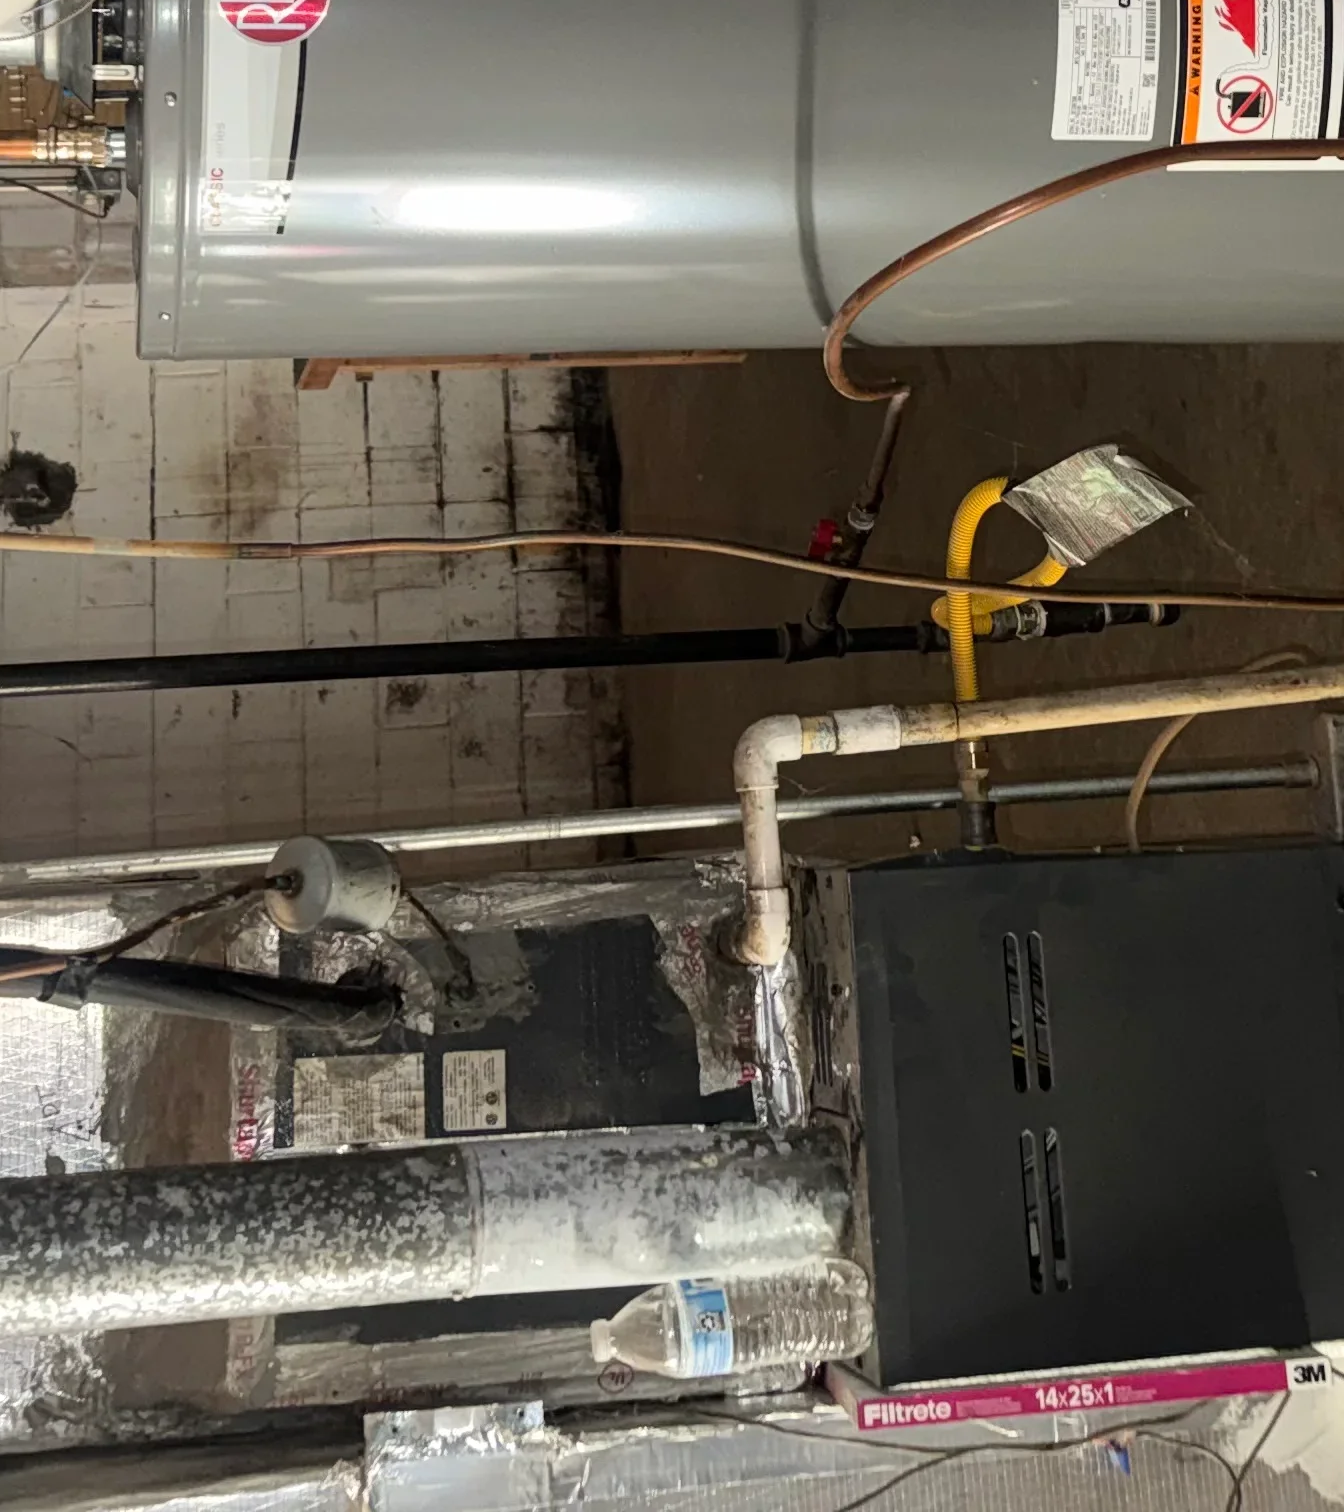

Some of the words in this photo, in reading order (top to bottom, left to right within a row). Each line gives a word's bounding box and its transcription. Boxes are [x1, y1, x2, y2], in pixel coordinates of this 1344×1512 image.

[1191, 4, 1202, 78] WARNING
[1293, 1363, 1327, 1384] 3M
[1034, 1382, 1116, 1411] 14x25x1
[862, 1399, 953, 1427] Filtrete
